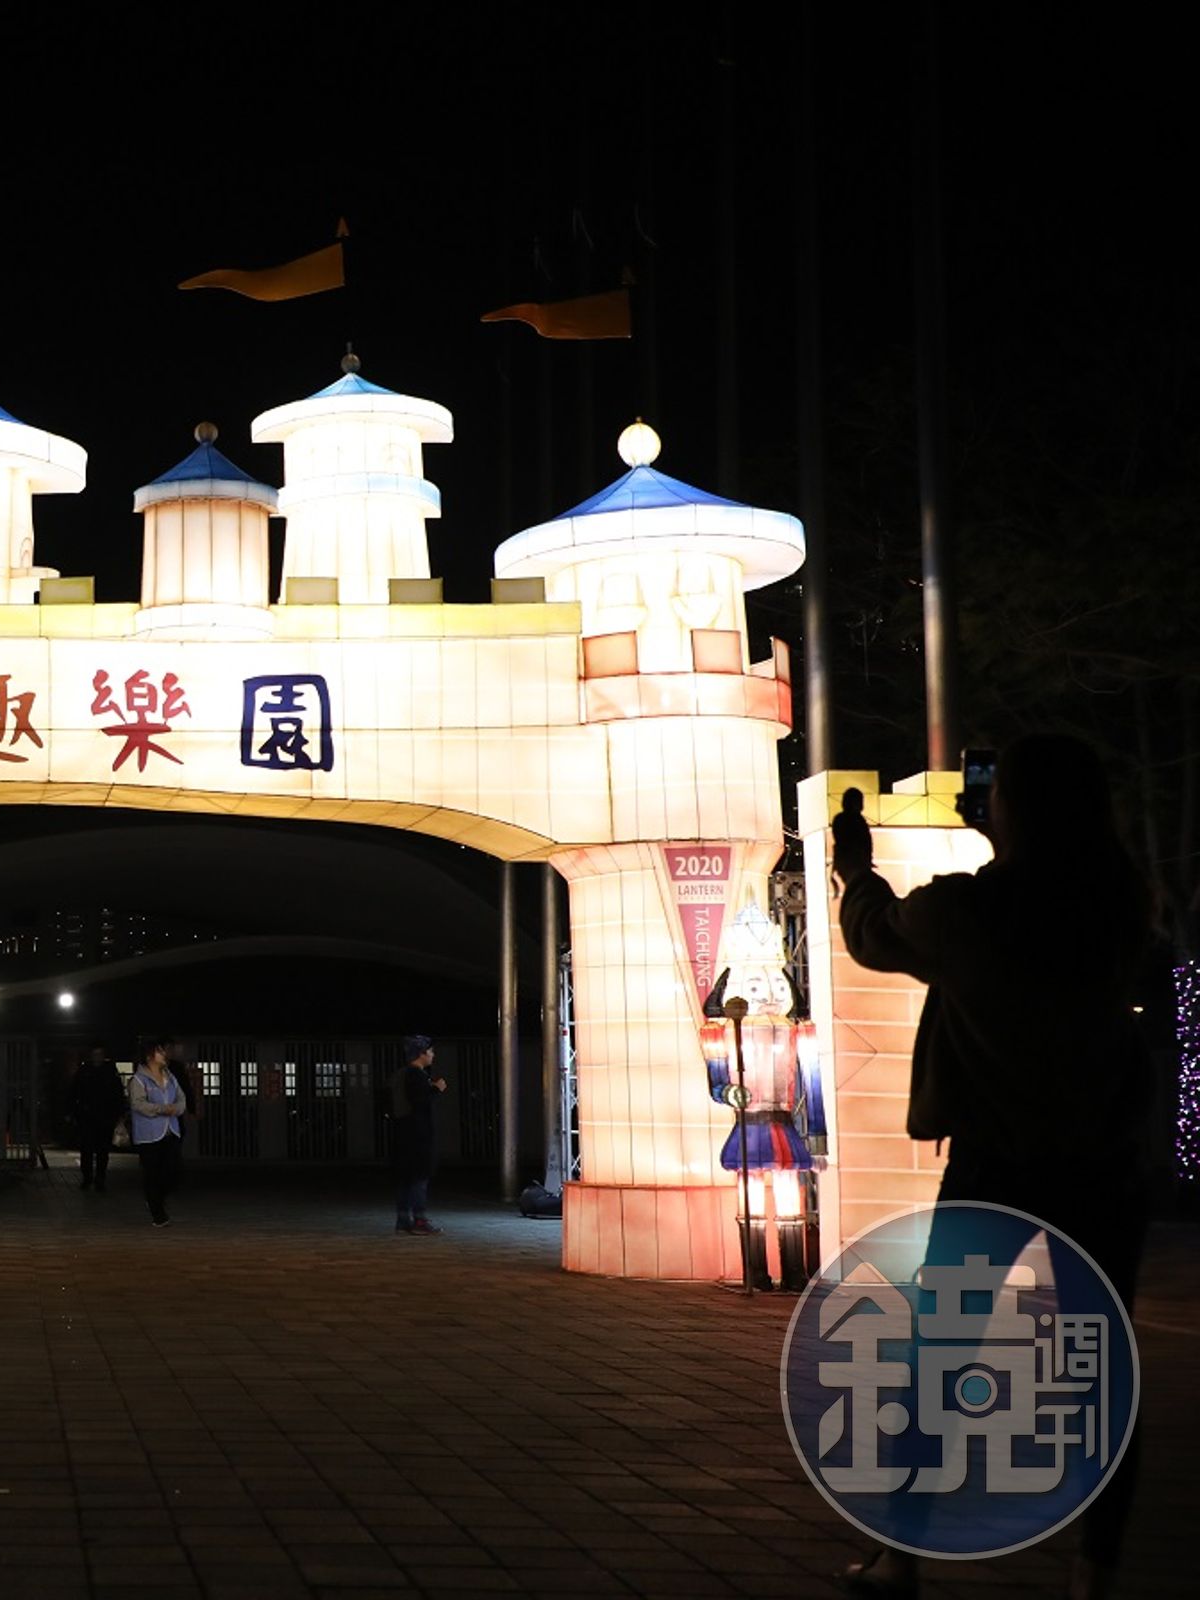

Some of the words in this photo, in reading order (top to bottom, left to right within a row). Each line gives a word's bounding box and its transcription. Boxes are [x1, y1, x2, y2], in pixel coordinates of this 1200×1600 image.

[675, 856, 723, 877] 2020
[678, 885, 724, 896] LANTERN
[694, 907, 712, 987] TAICHUNG
